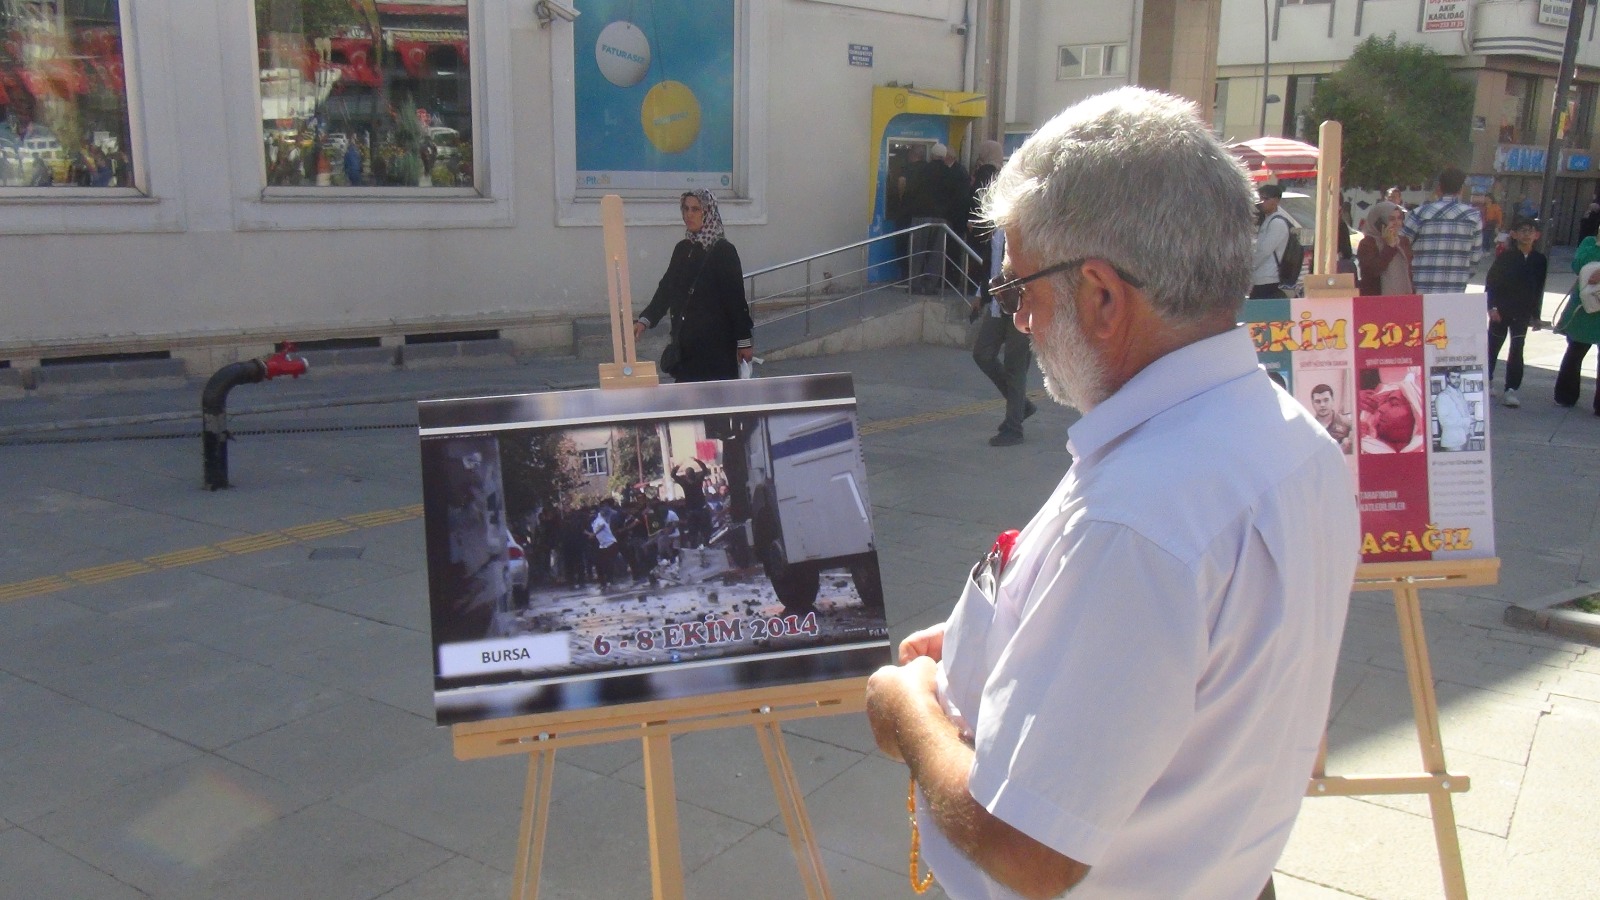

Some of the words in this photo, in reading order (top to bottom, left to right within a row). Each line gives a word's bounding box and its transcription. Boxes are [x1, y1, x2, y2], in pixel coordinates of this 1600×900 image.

[1249, 311, 1348, 351] EKİM
[1358, 318, 1449, 350] 2014
[593, 634, 611, 656] 6
[636, 630, 655, 651] 8
[661, 614, 744, 649] EKİM
[750, 612, 819, 640] 2014
[481, 648, 531, 664] BURSA
